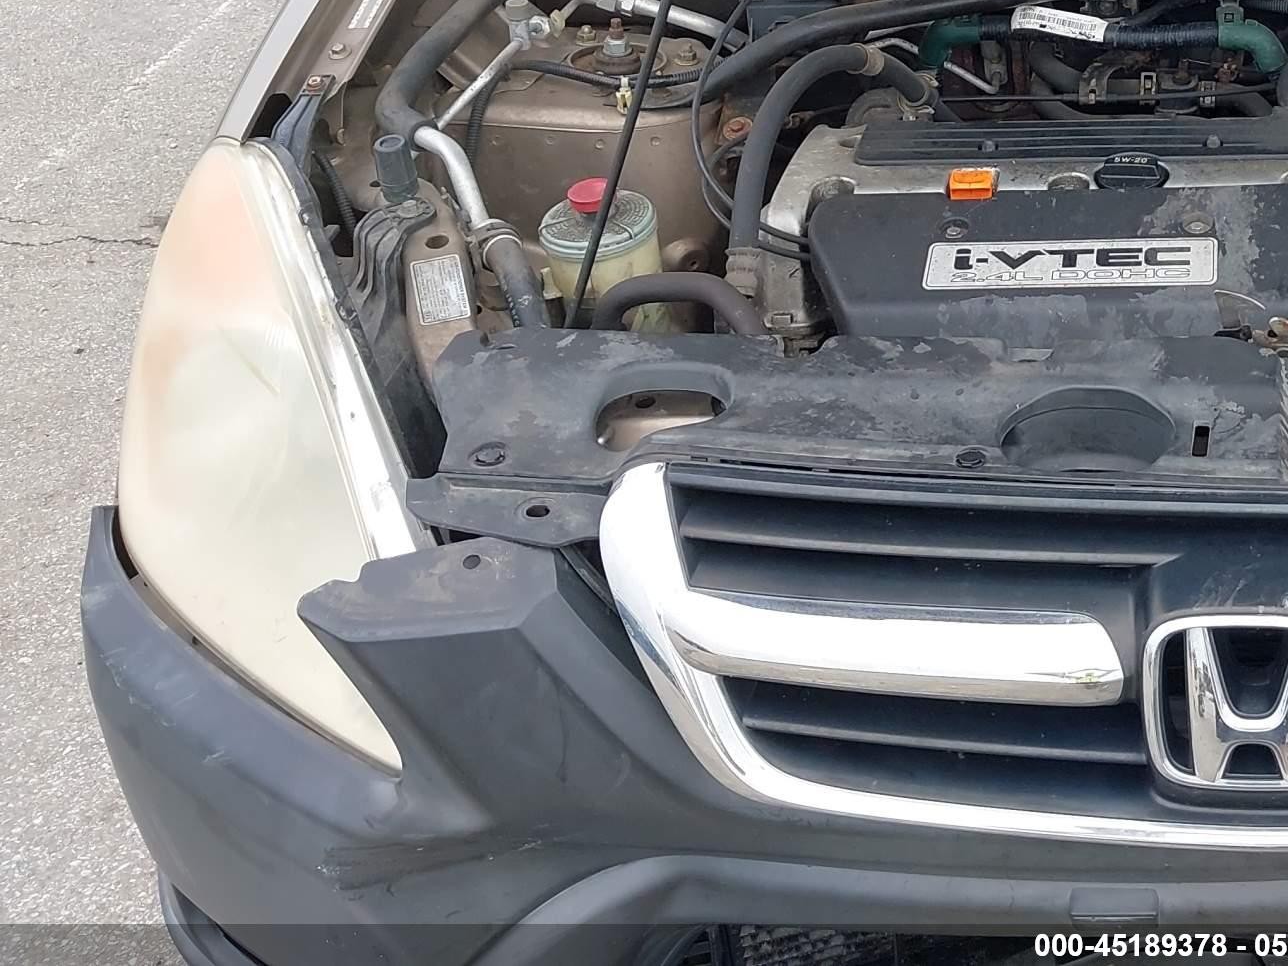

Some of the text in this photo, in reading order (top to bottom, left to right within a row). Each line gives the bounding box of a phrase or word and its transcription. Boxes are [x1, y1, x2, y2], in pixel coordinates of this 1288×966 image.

[953, 247, 1191, 271] i-VTEC
[951, 268, 1190, 282] 2.4L DOHC
